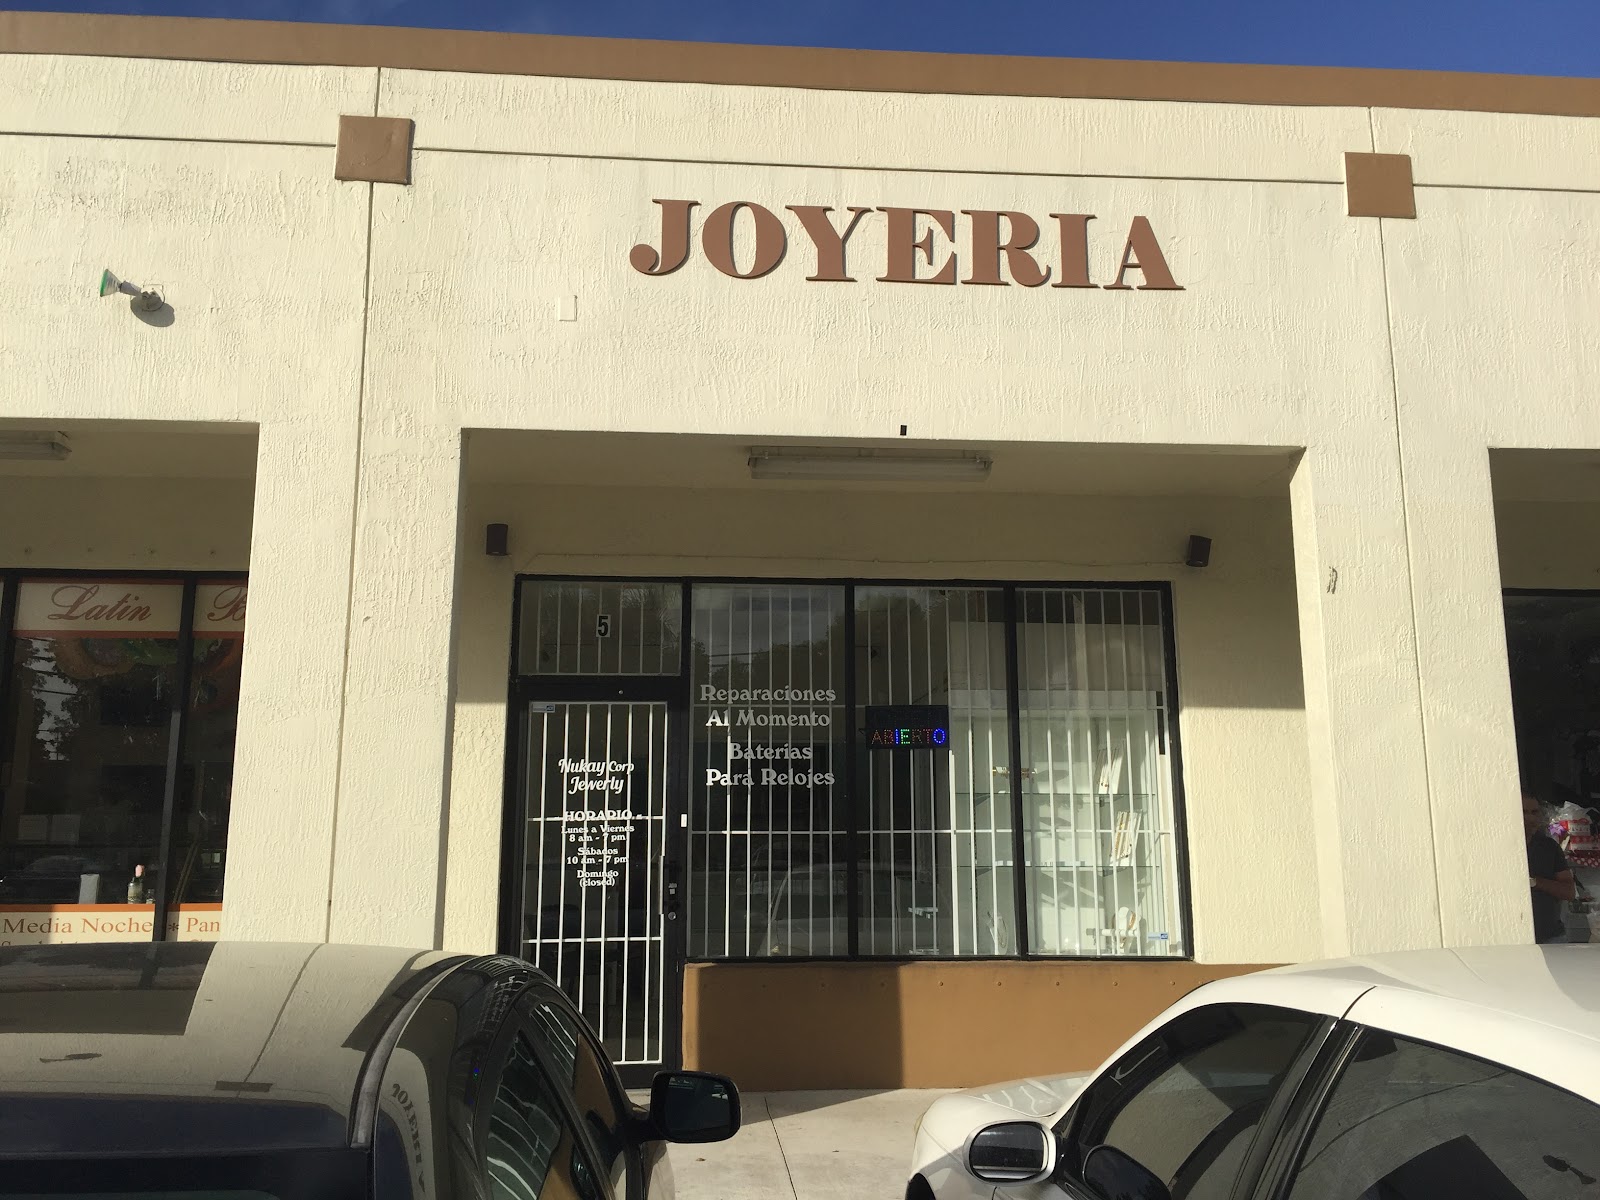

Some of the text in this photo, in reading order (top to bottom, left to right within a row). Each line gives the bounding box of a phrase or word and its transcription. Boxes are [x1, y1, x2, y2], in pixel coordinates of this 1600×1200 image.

[629, 199, 1185, 290] JOYERIA
[47, 584, 152, 621] Latin
[598, 616, 609, 636] 5
[700, 684, 836, 704] Reparaciones
[706, 709, 831, 726] Al Momento
[871, 728, 946, 745] ABIERTO
[729, 743, 813, 760] Baterias
[558, 758, 635, 776] Nukay Corp
[568, 776, 624, 794] Jewerly
[706, 768, 836, 788] Para Relojes
[564, 809, 633, 821] HORARIO
[561, 825, 588, 834] Lunes
[600, 824, 635, 833] Viernes
[569, 834, 576, 842] 8
[611, 834, 626, 842] pm
[567, 856, 579, 865] 10
[605, 855, 612, 863] 7
[614, 856, 629, 864] pm
[577, 870, 619, 878] Domingo
[2, 916, 220, 934] Media Noche Pan
